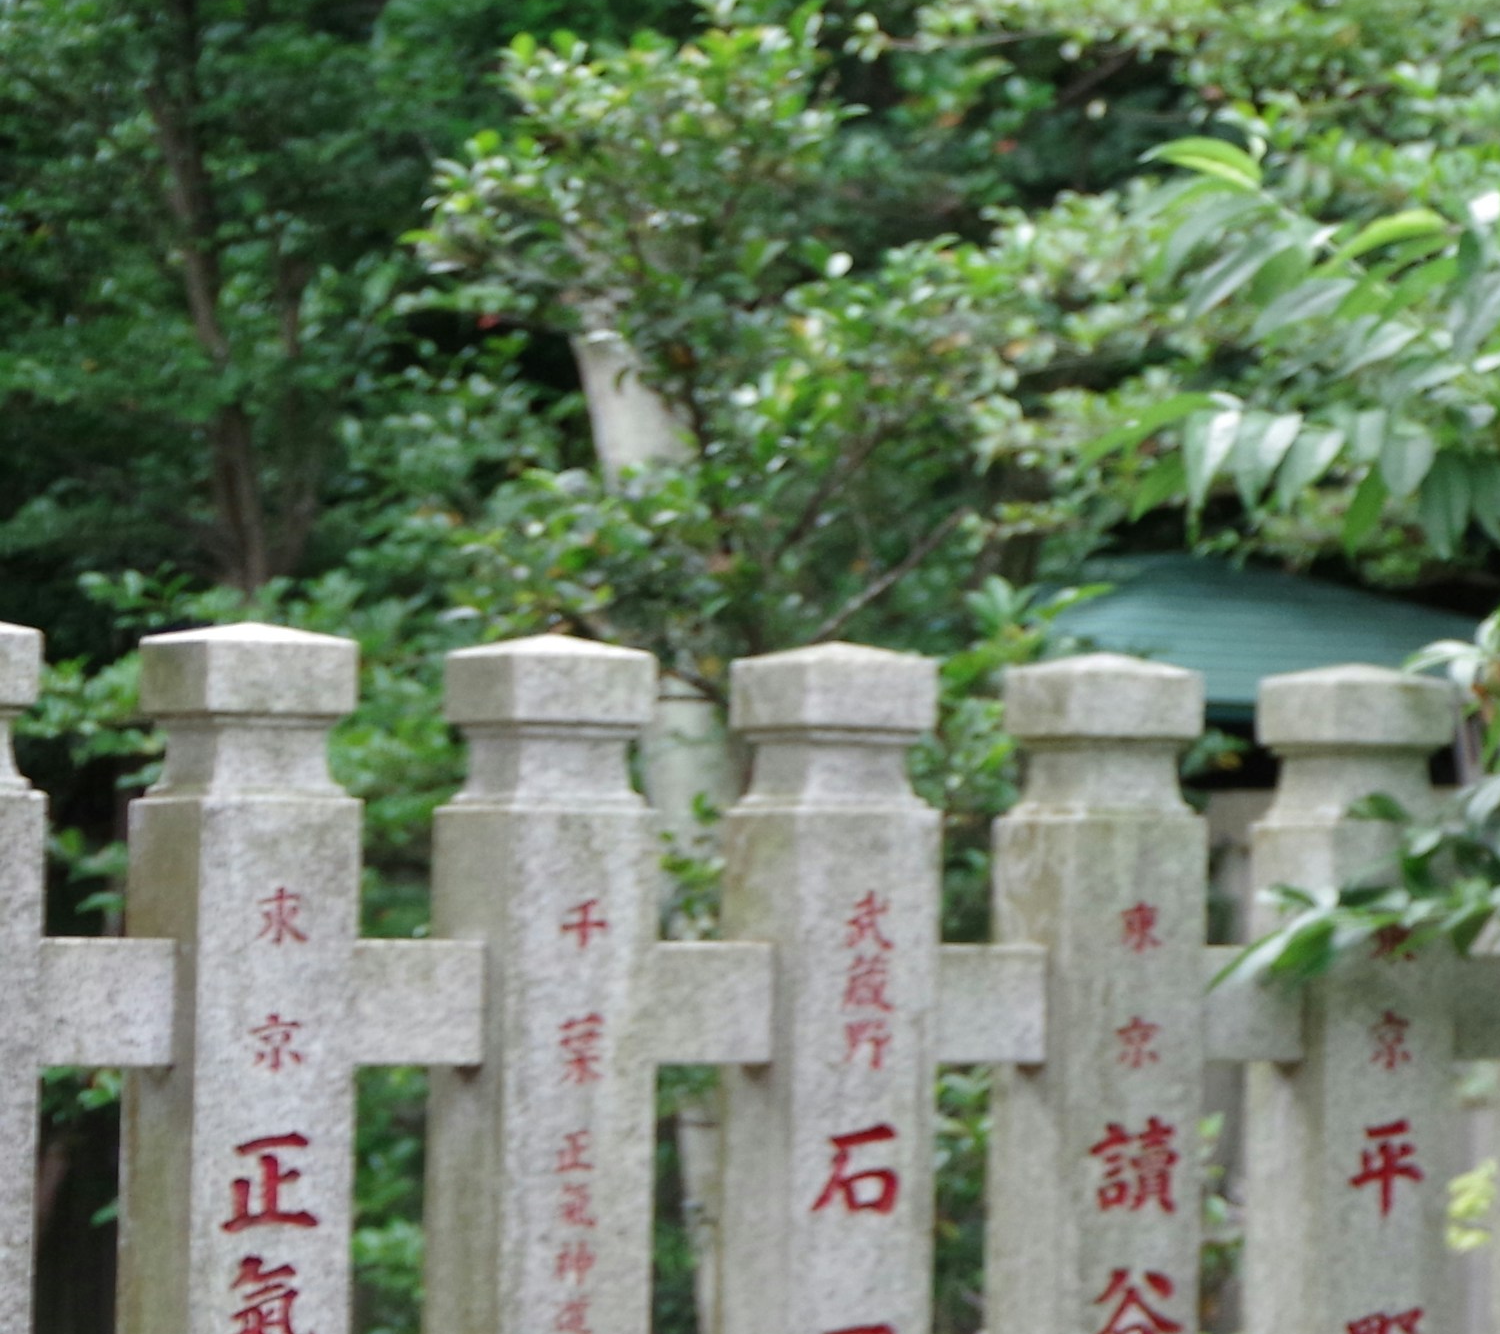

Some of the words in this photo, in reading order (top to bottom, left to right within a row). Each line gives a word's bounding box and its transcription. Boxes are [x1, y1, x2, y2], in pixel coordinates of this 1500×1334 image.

[247, 886, 309, 1073] 東京
[558, 897, 612, 1085] 千葉
[1115, 900, 1163, 1069] 東京
